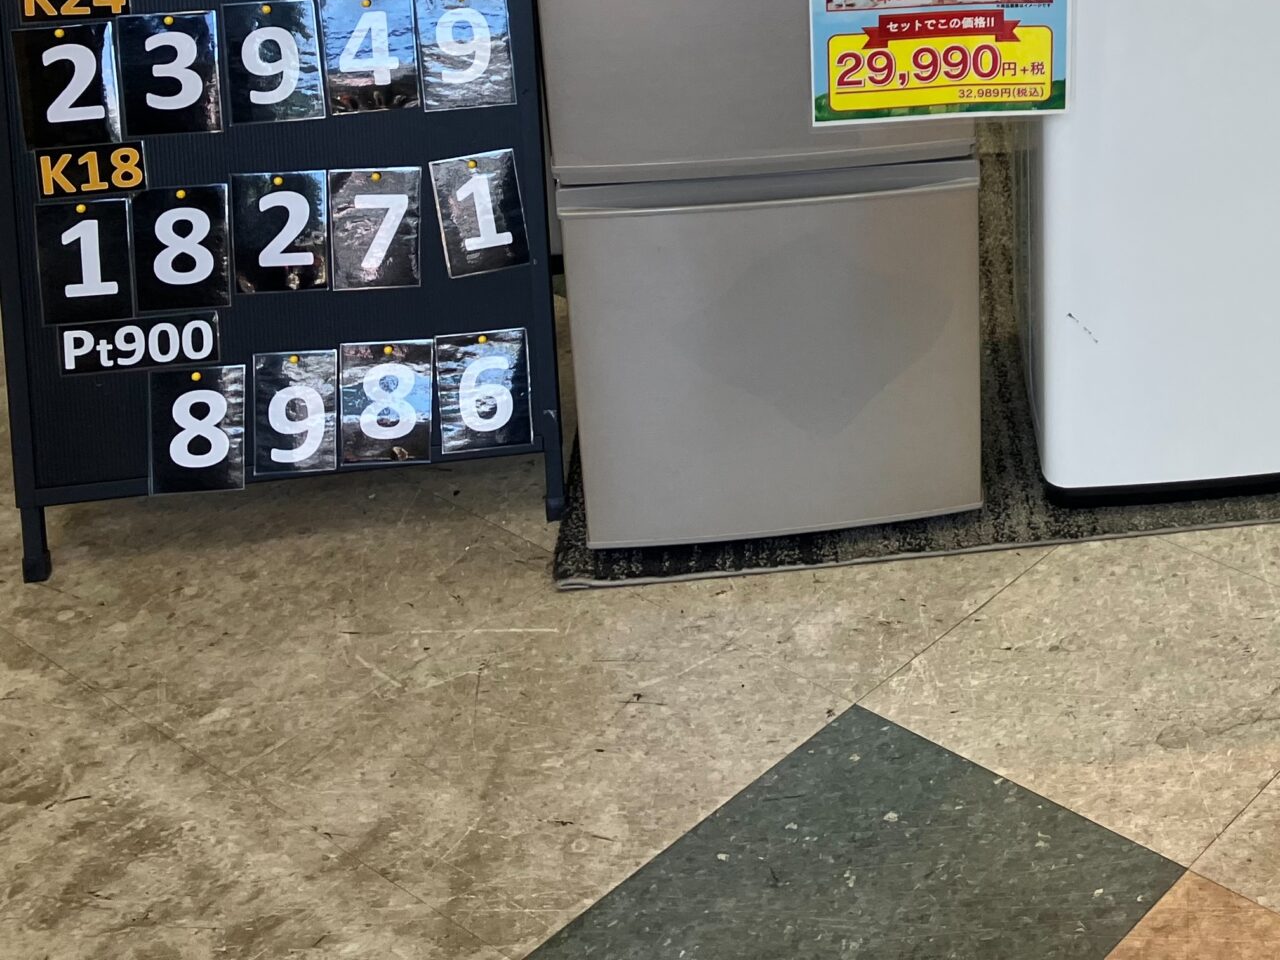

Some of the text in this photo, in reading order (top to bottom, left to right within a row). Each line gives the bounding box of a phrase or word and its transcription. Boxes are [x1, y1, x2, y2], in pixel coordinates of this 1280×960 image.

[887, 17, 995, 33] セットでこの価格!!
[836, 44, 1046, 89] 29,990円+税
[958, 86, 1045, 99] 32,989円(税込)
[39, 147, 144, 195] K18
[62, 319, 213, 371] Pt900
[168, 356, 514, 468] 8986
